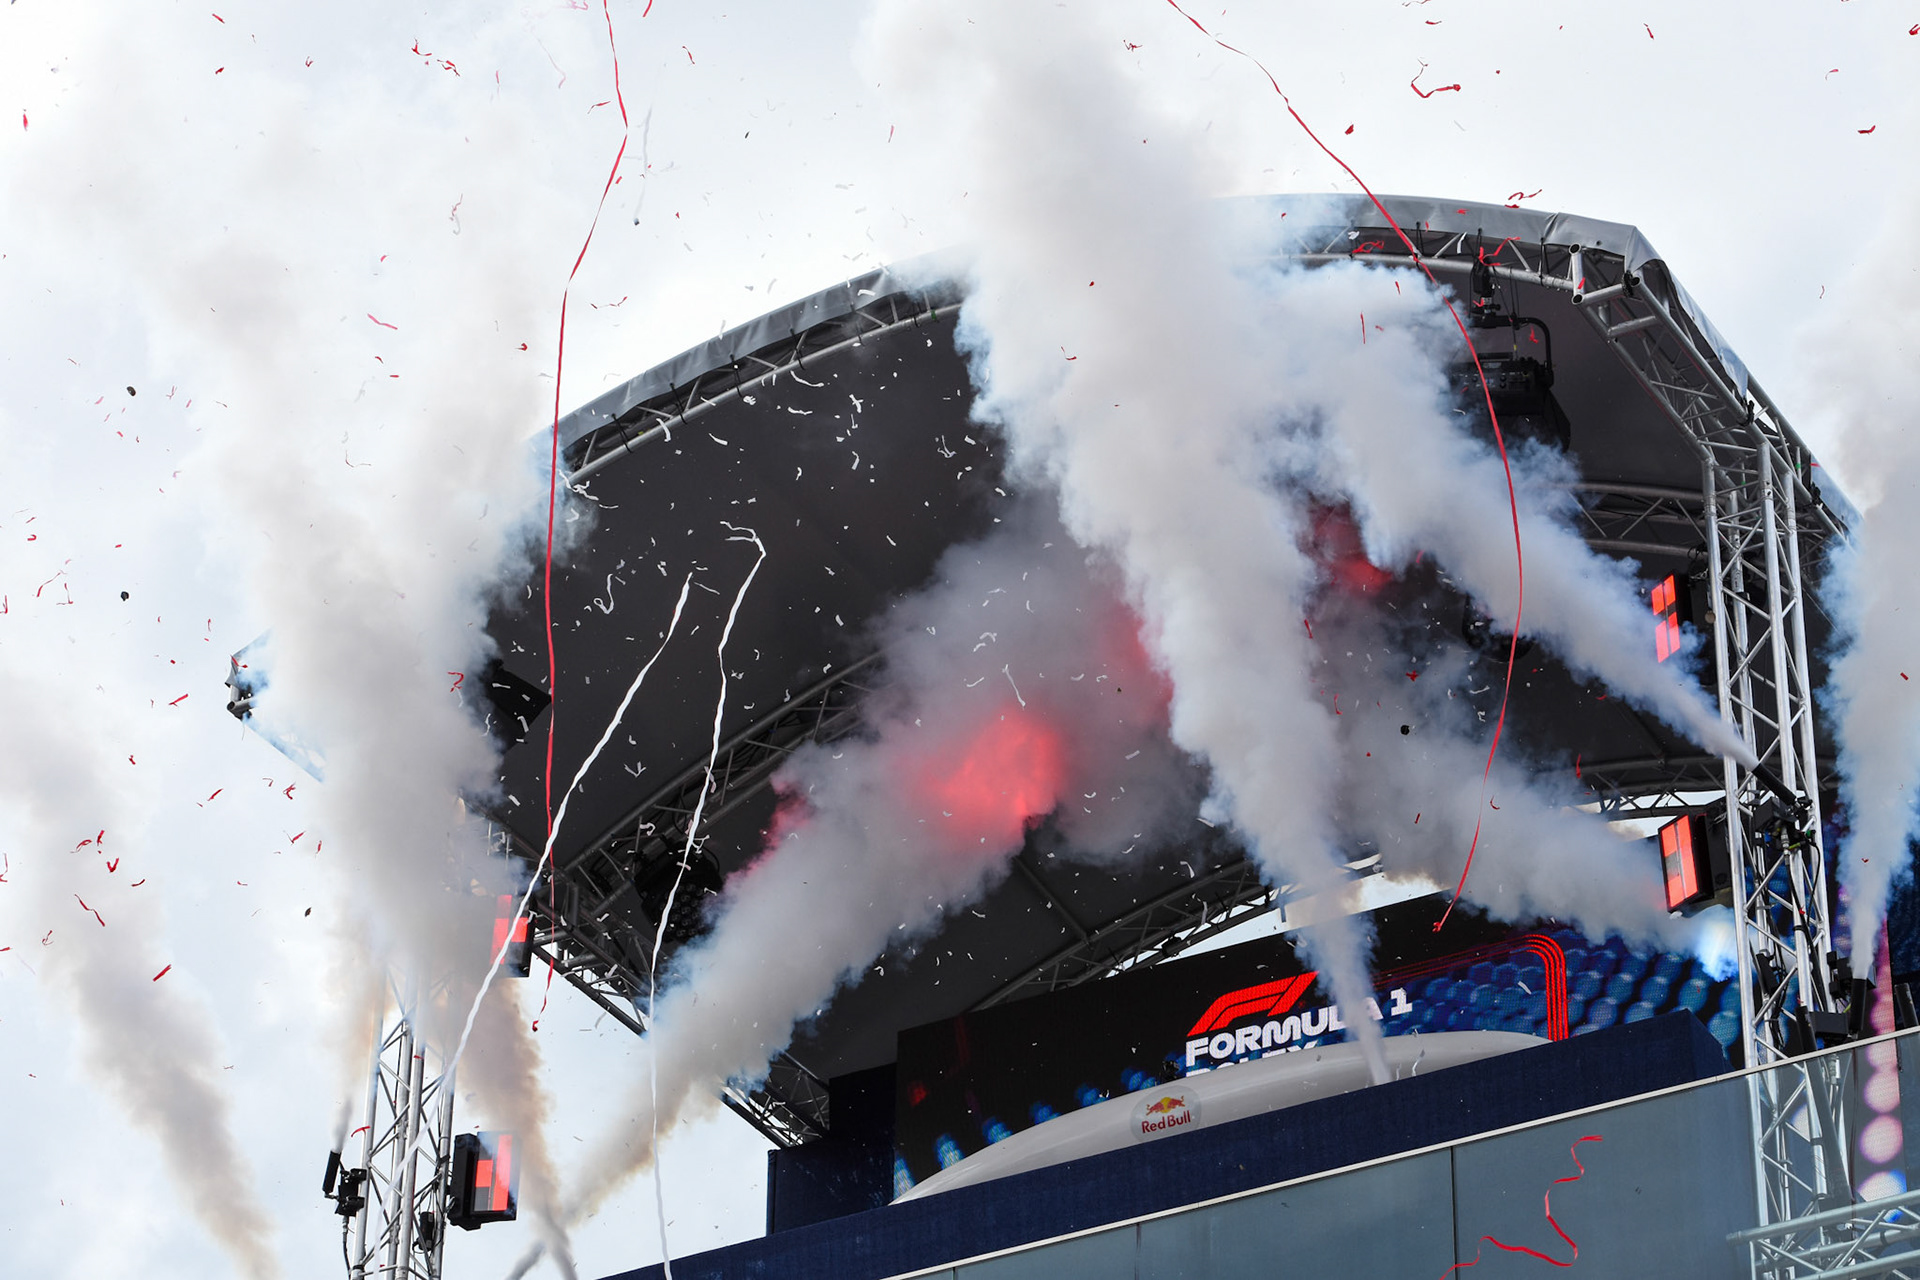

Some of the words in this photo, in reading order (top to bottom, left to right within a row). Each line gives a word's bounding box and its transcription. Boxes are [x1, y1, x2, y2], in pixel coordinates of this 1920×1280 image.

[1391, 988, 1413, 1016] 1
[1141, 1116, 1166, 1134] Red
[1167, 1110, 1191, 1128] Bull
